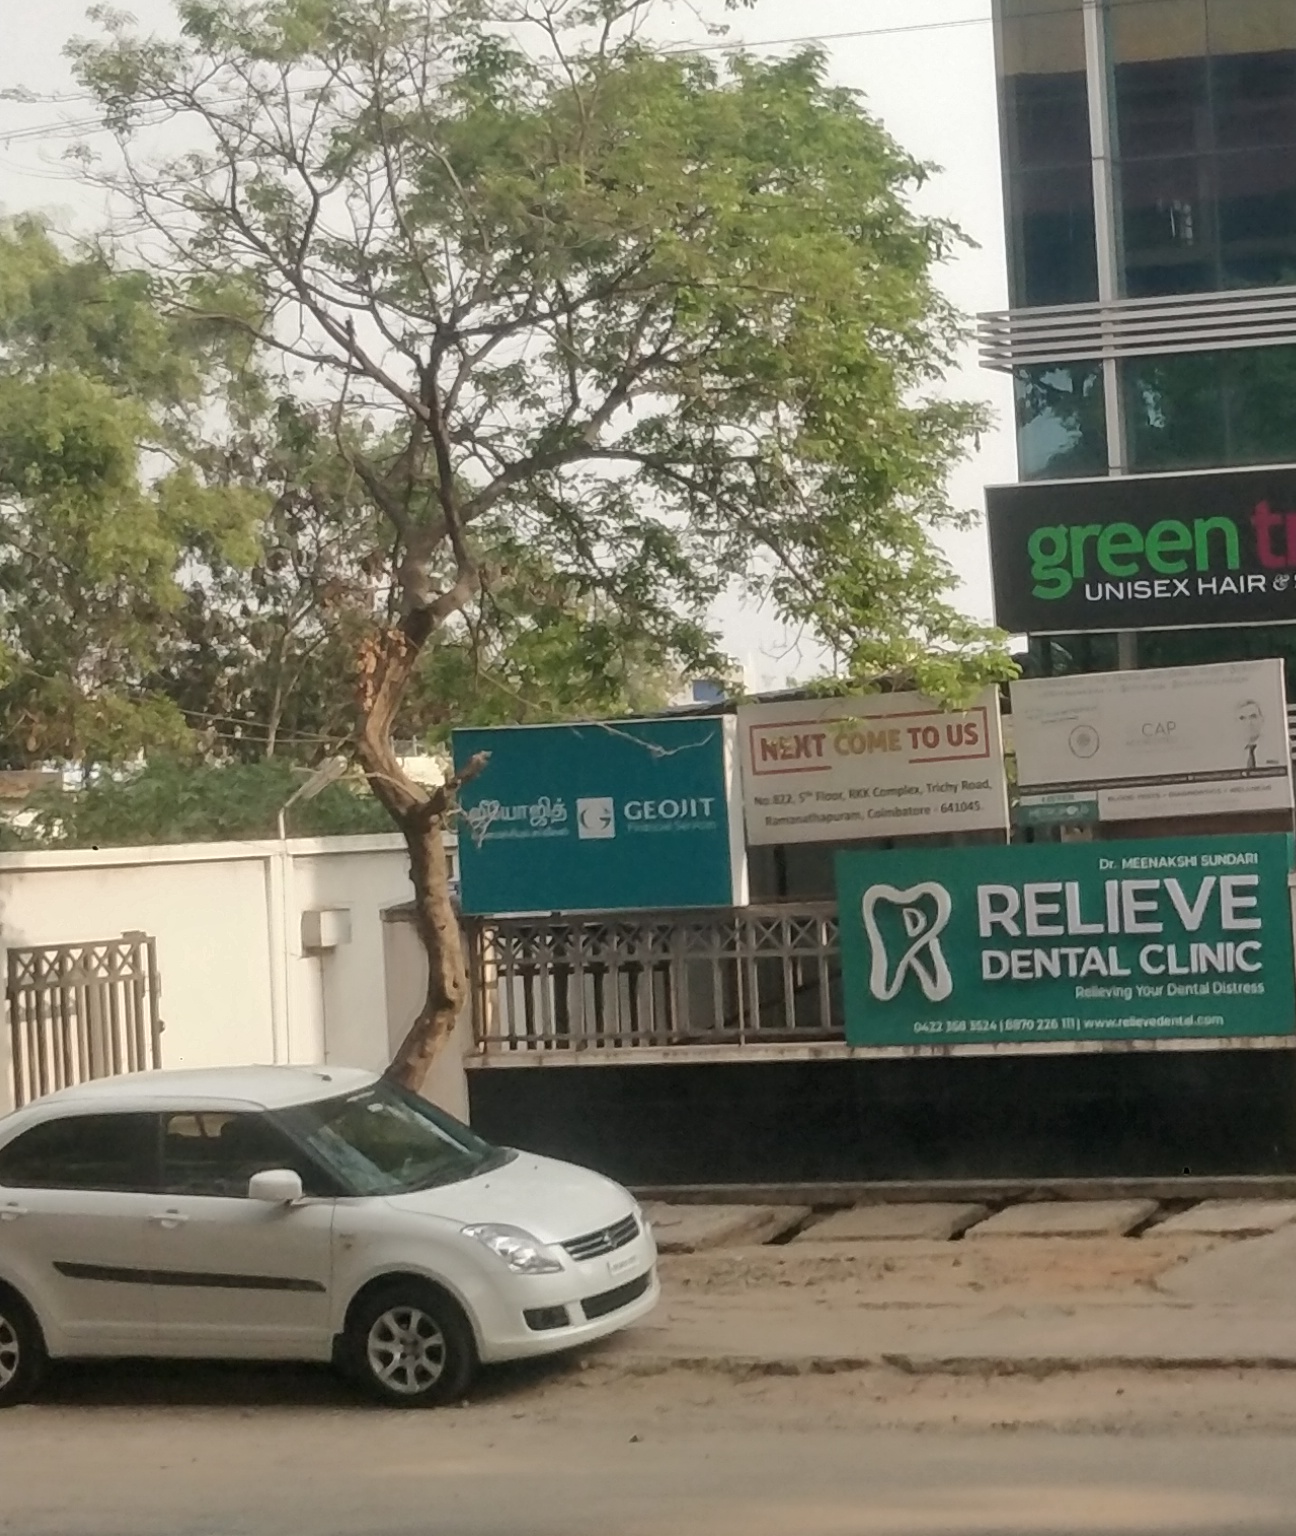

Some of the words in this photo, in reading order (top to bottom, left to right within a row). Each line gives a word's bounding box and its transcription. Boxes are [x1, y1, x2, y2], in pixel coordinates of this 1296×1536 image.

[1028, 515, 1240, 600] green
[1085, 578, 1191, 601] UNISEX
[1198, 574, 1267, 596] HAIR
[1141, 720, 1177, 738] CAP
[760, 733, 827, 761] NEXT
[833, 730, 902, 756] COME
[907, 726, 940, 750] TO
[946, 722, 979, 747] US
[873, 785, 922, 799] Complex,
[926, 782, 958, 795] Trichy
[961, 778, 993, 789] Road,
[624, 798, 715, 820] GEOJIT
[867, 803, 931, 819] Coimbatore
[1099, 858, 1117, 871] Dr.
[1121, 854, 1198, 869] MEENAKSHI
[1201, 852, 1259, 867] SUNDARI
[977, 874, 1262, 937] RELIEVE
[982, 946, 1131, 981] DENTAL
[1139, 940, 1263, 975] CLINIC
[1075, 985, 1133, 1001] Relieving
[1135, 985, 1164, 998] Your
[1167, 982, 1210, 997] Dental
[1212, 981, 1265, 995] Distress
[913, 1021, 944, 1034] 0422
[1083, 1013, 1225, 1030] www.relievedental.com
